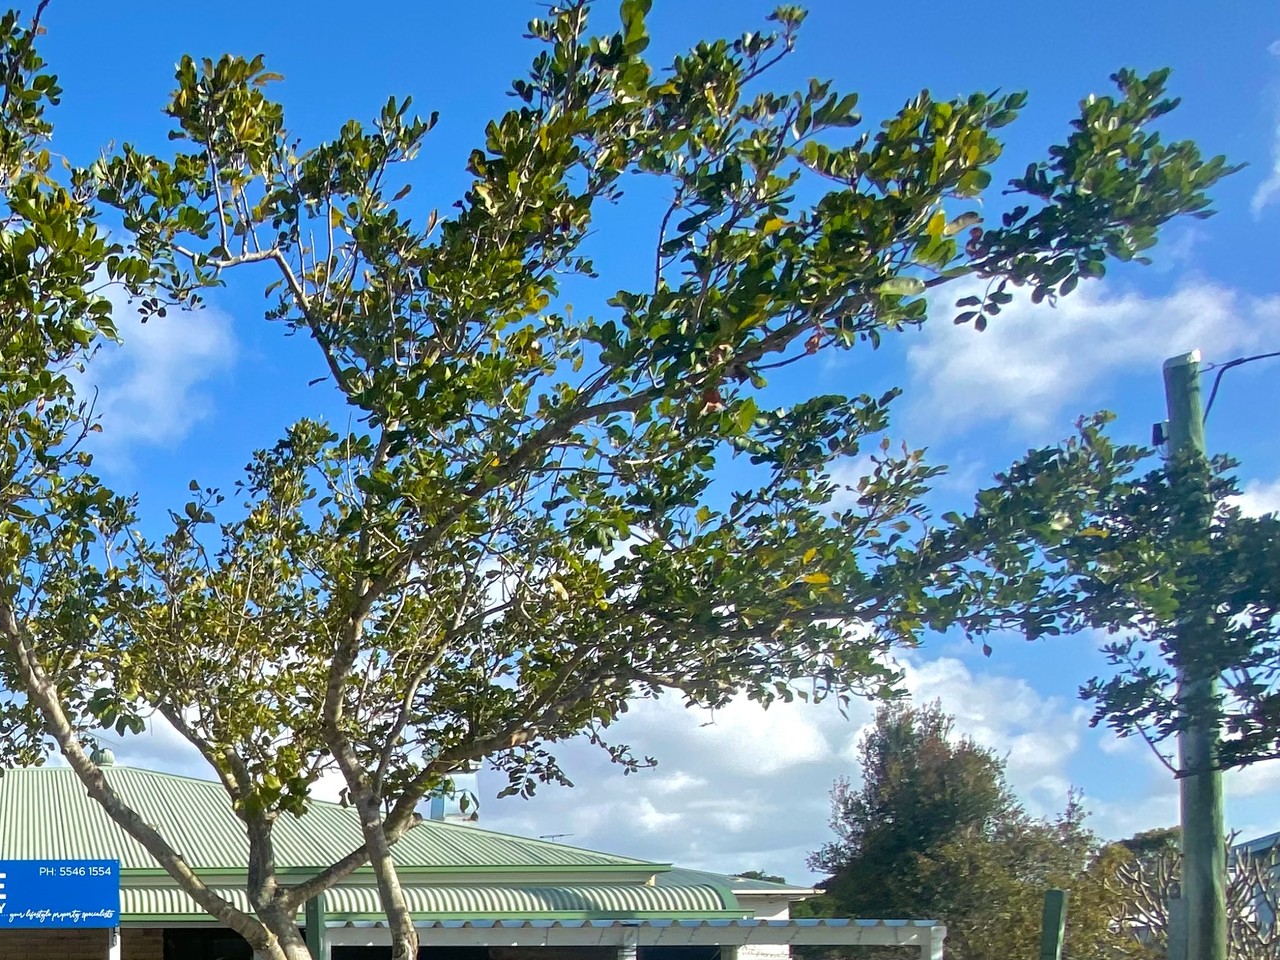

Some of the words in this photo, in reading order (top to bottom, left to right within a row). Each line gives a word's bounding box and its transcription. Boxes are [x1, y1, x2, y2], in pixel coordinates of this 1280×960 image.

[39, 866, 57, 877] PH:
[59, 866, 86, 877] 5546
[88, 866, 112, 877] 1554
[8, 912, 25, 923] your
[26, 908, 52, 923] lifestyle
[51, 909, 81, 923] property
[81, 909, 116, 922] specialists
